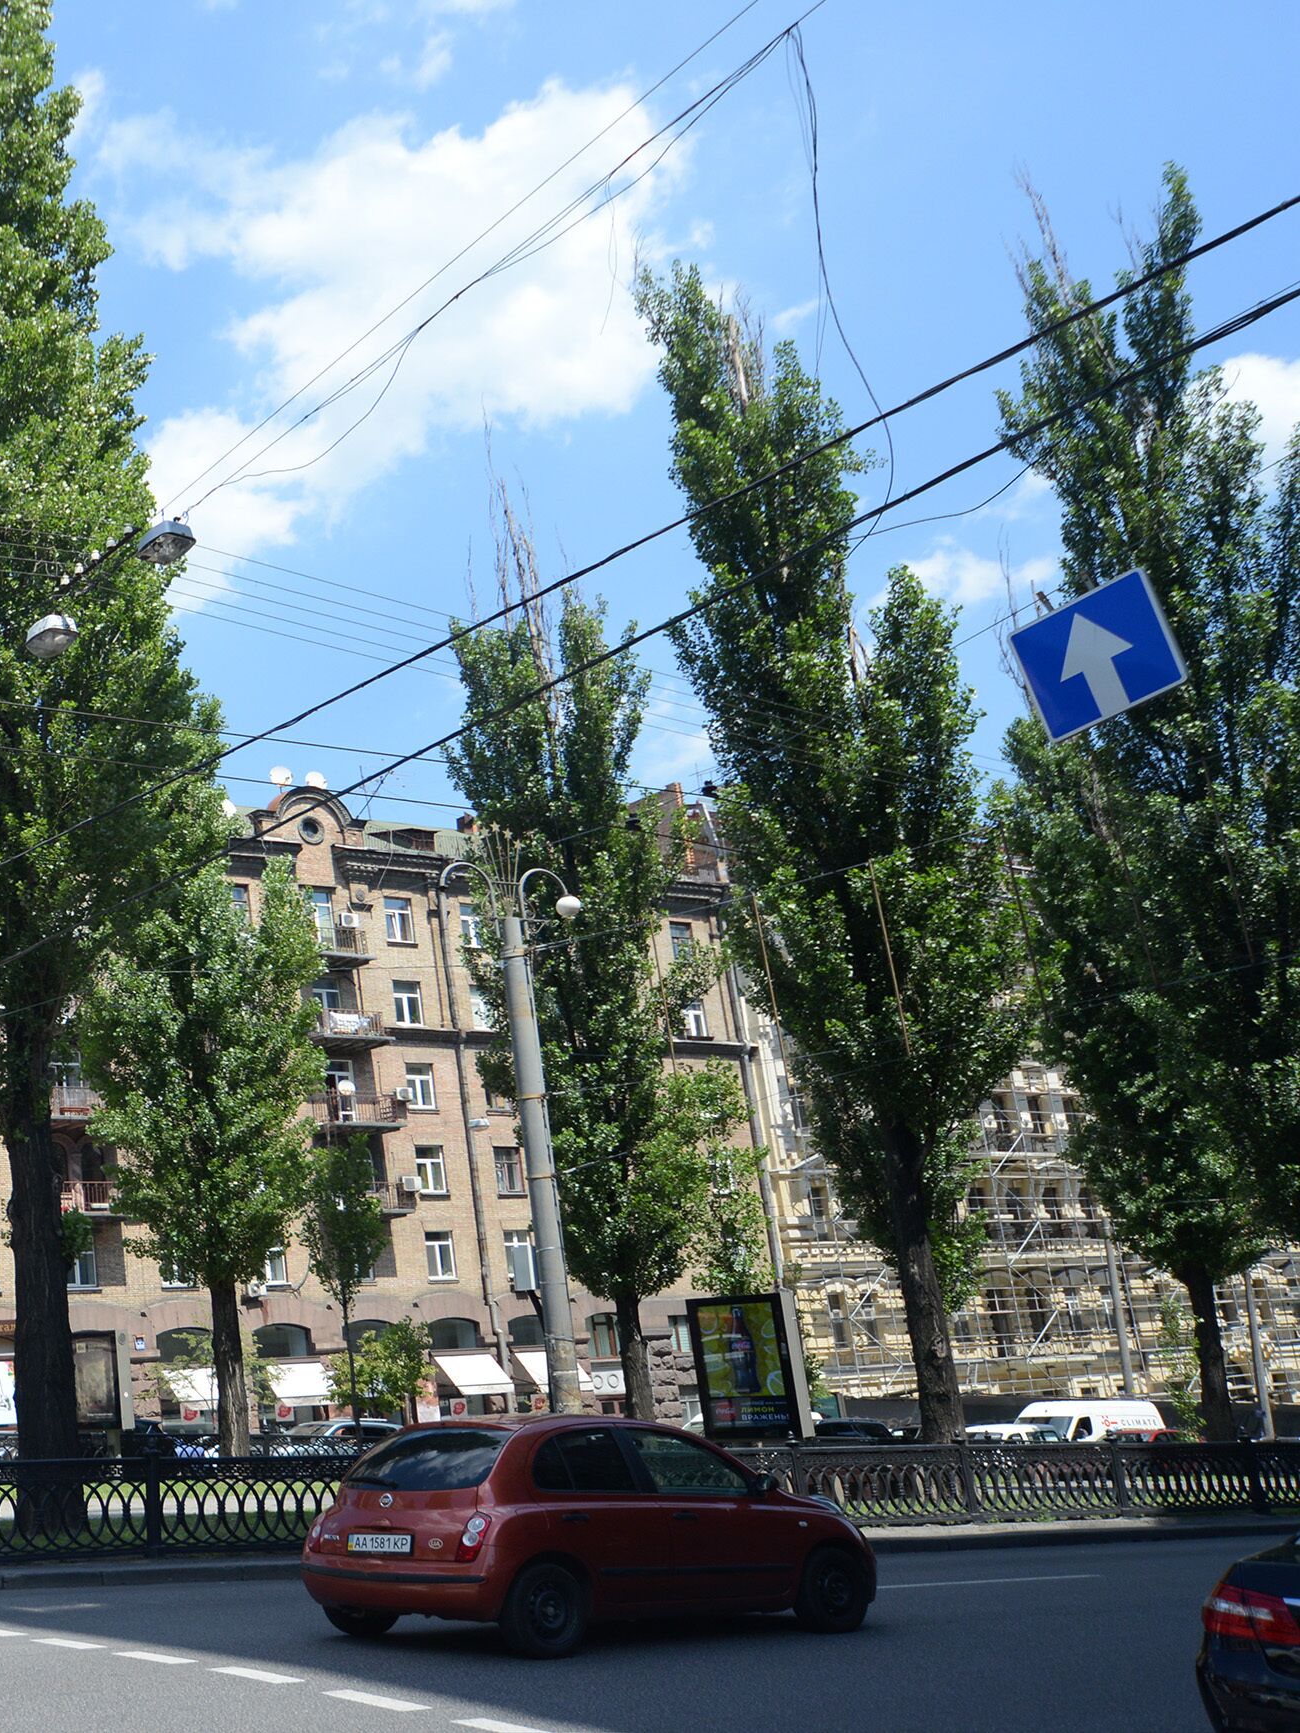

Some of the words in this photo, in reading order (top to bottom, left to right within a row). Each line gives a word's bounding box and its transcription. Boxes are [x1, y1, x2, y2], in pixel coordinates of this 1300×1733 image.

[1121, 1418, 1158, 1427] CLIMATE
[355, 1537, 368, 1549] AA
[369, 1536, 391, 1550] 1581
[393, 1538, 409, 1550] KP
